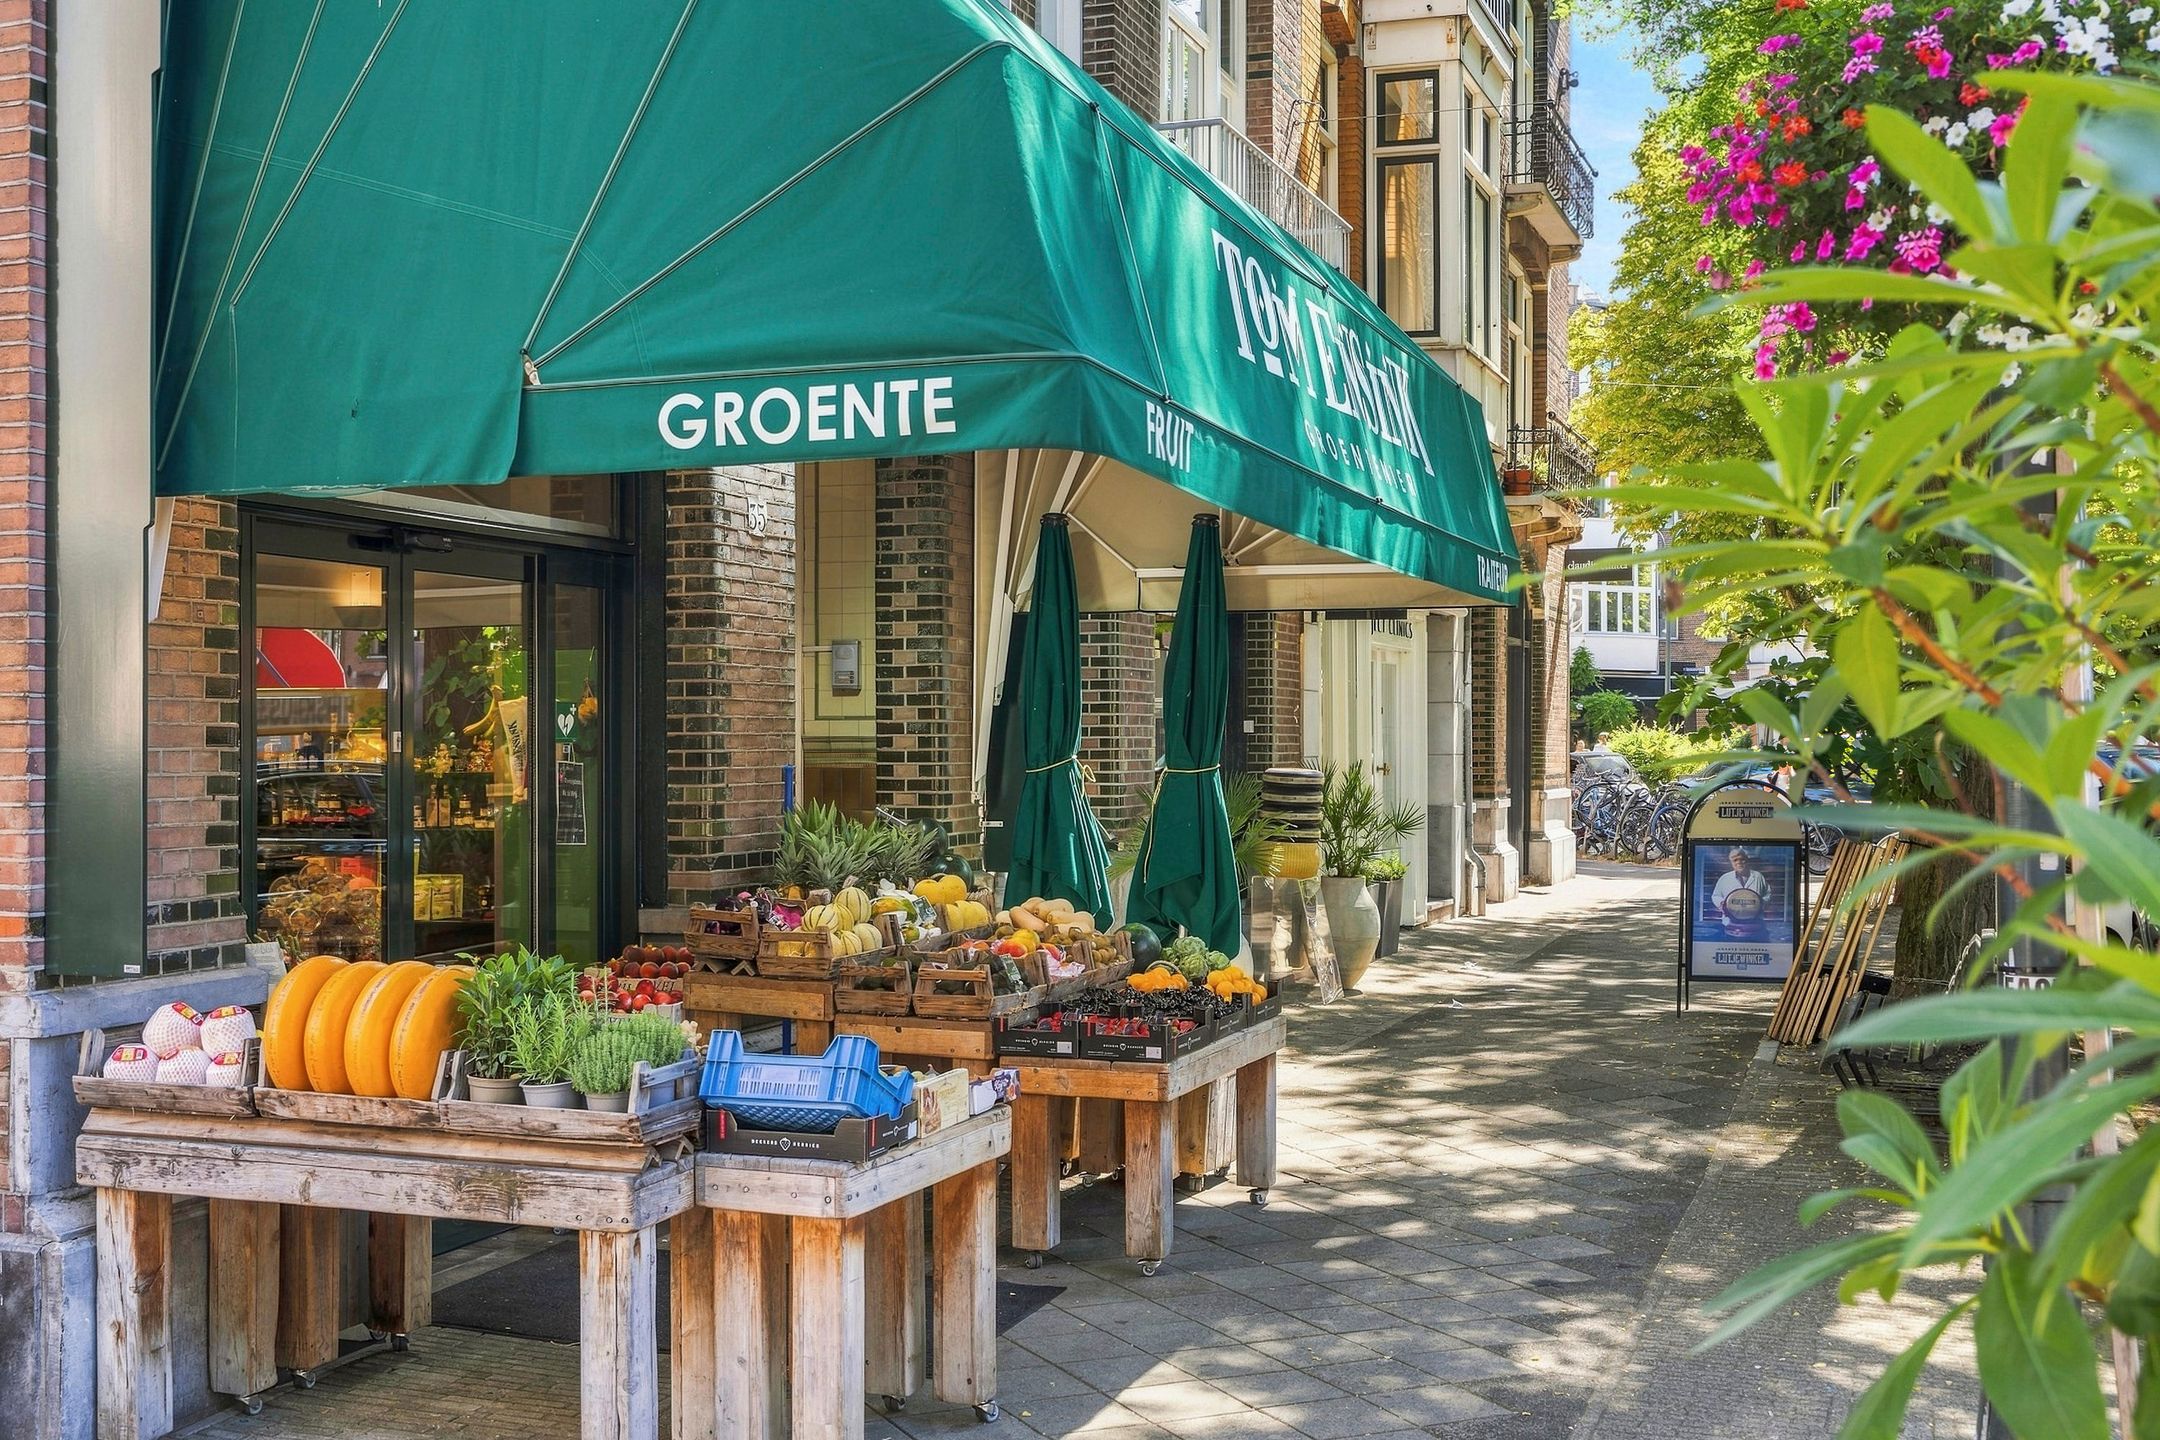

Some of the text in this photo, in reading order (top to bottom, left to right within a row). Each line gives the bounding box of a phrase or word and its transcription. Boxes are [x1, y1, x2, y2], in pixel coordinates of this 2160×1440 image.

[1211, 228, 1317, 399] TOM
[658, 376, 957, 450] GROENTE
[1145, 399, 1195, 474] FRUIT
[749, 502, 766, 533] 35
[1477, 553, 1510, 594] TRAITEUR
[1567, 560, 1596, 571] claudi
[1720, 807, 1772, 818] LUTJEWINKEL
[1718, 953, 1767, 964] LUTJEWINKEL
